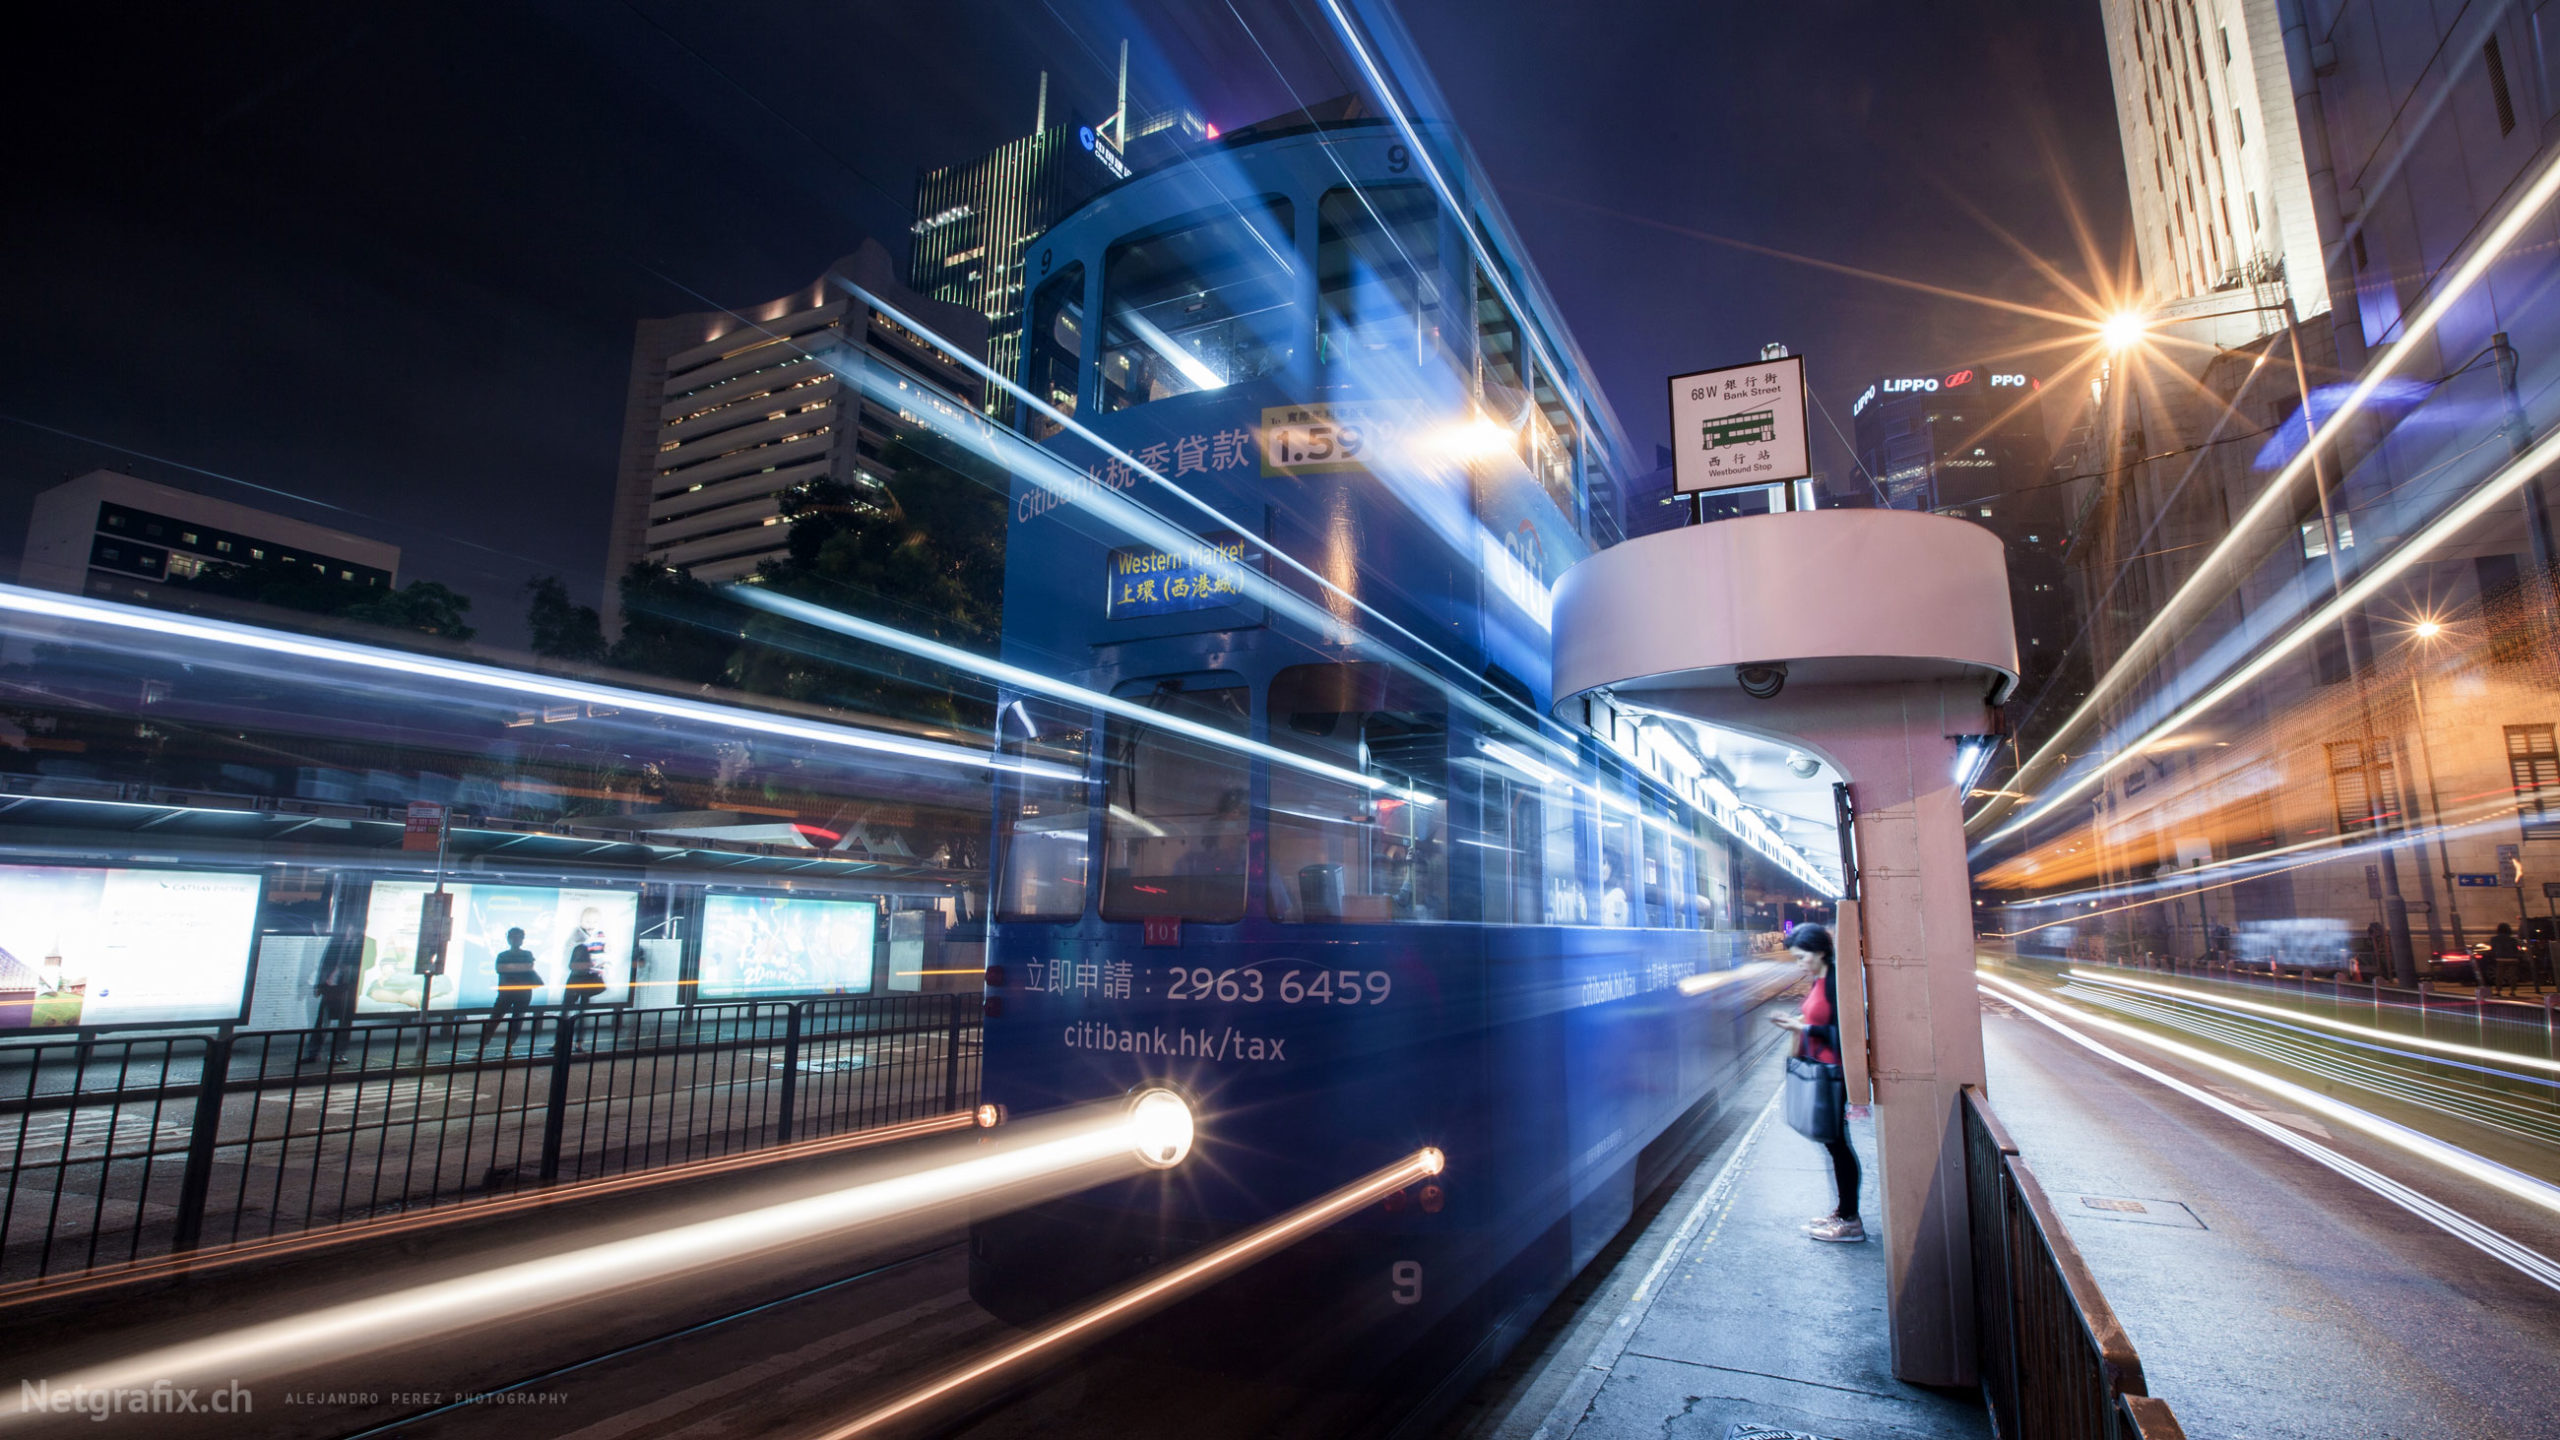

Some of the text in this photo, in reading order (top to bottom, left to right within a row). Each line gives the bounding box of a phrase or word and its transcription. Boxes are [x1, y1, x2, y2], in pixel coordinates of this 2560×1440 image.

[1387, 145, 1410, 173] 9
[1041, 248, 1052, 275] 9
[1724, 373, 1778, 390] 銀行街
[1724, 385, 1781, 401] Bank Street
[1883, 379, 1939, 392] LIPPO
[1853, 384, 1876, 417] LIPPO
[1708, 450, 1770, 467] 西行站
[1708, 463, 1772, 477] Westbound Stop
[1118, 539, 1245, 575] Western Market
[1148, 924, 1179, 941] 101
[1167, 967, 1264, 1002] 2963
[1280, 969, 1392, 1005] 6459
[1064, 1020, 1286, 1061] citibank.hk/tax
[1392, 1260, 1422, 1304] 9
